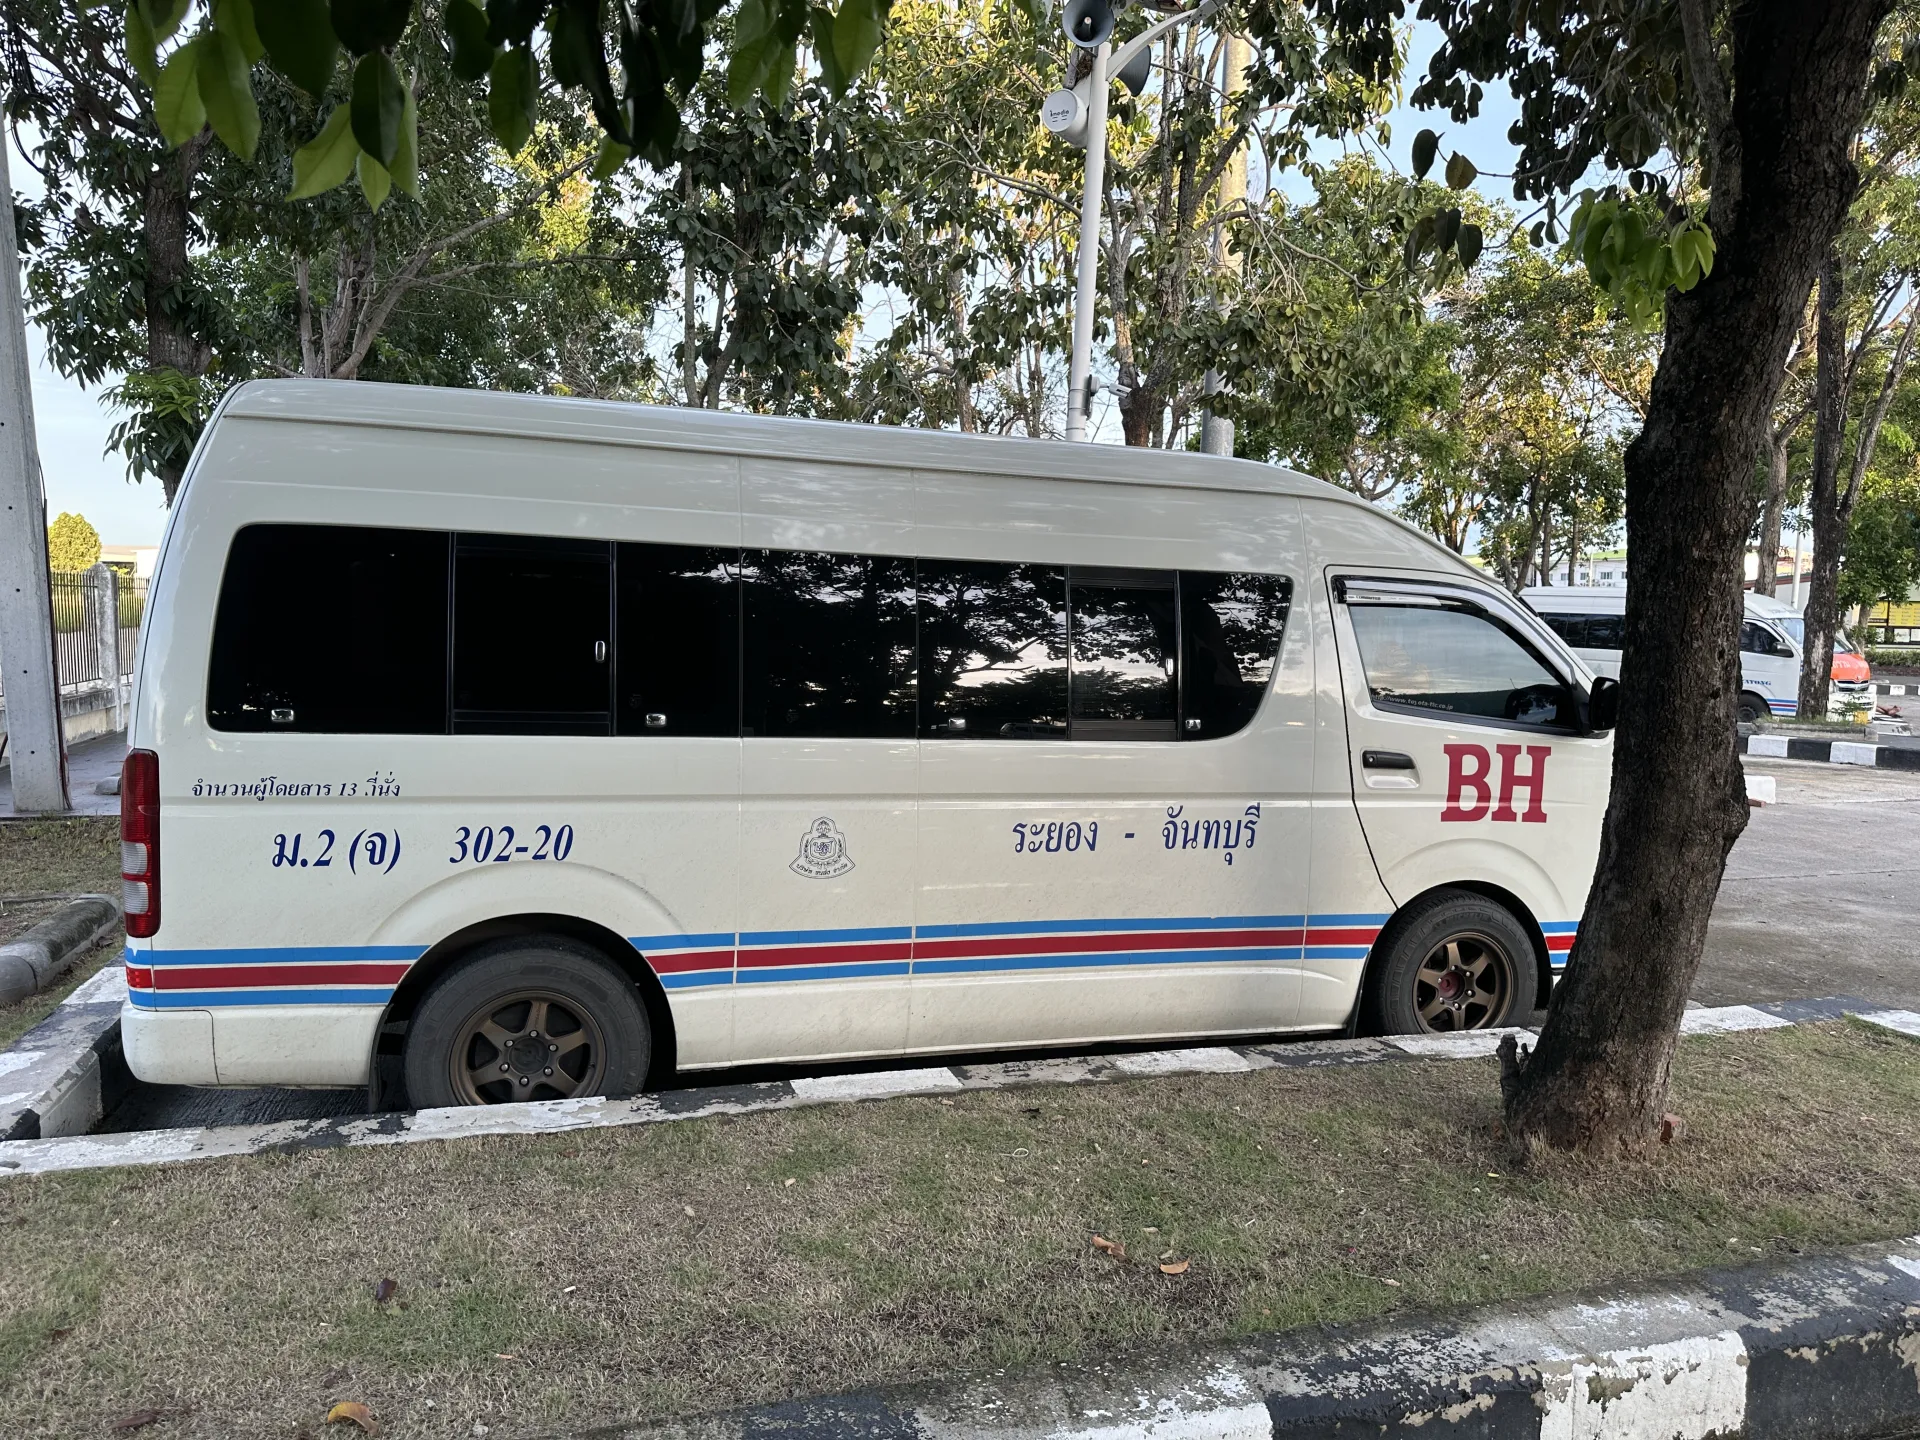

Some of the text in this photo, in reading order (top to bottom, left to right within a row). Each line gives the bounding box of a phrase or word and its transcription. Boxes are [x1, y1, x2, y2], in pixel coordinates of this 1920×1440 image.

[191, 776, 332, 801] จำนวนผู้โดยสาร
[337, 782, 358, 797] 13
[1440, 743, 1552, 823] BH
[272, 824, 574, 876] ม.2 (จ) 302-20
[1012, 821, 1098, 853] ระยอง
[1161, 802, 1261, 866] จันทบุรี
